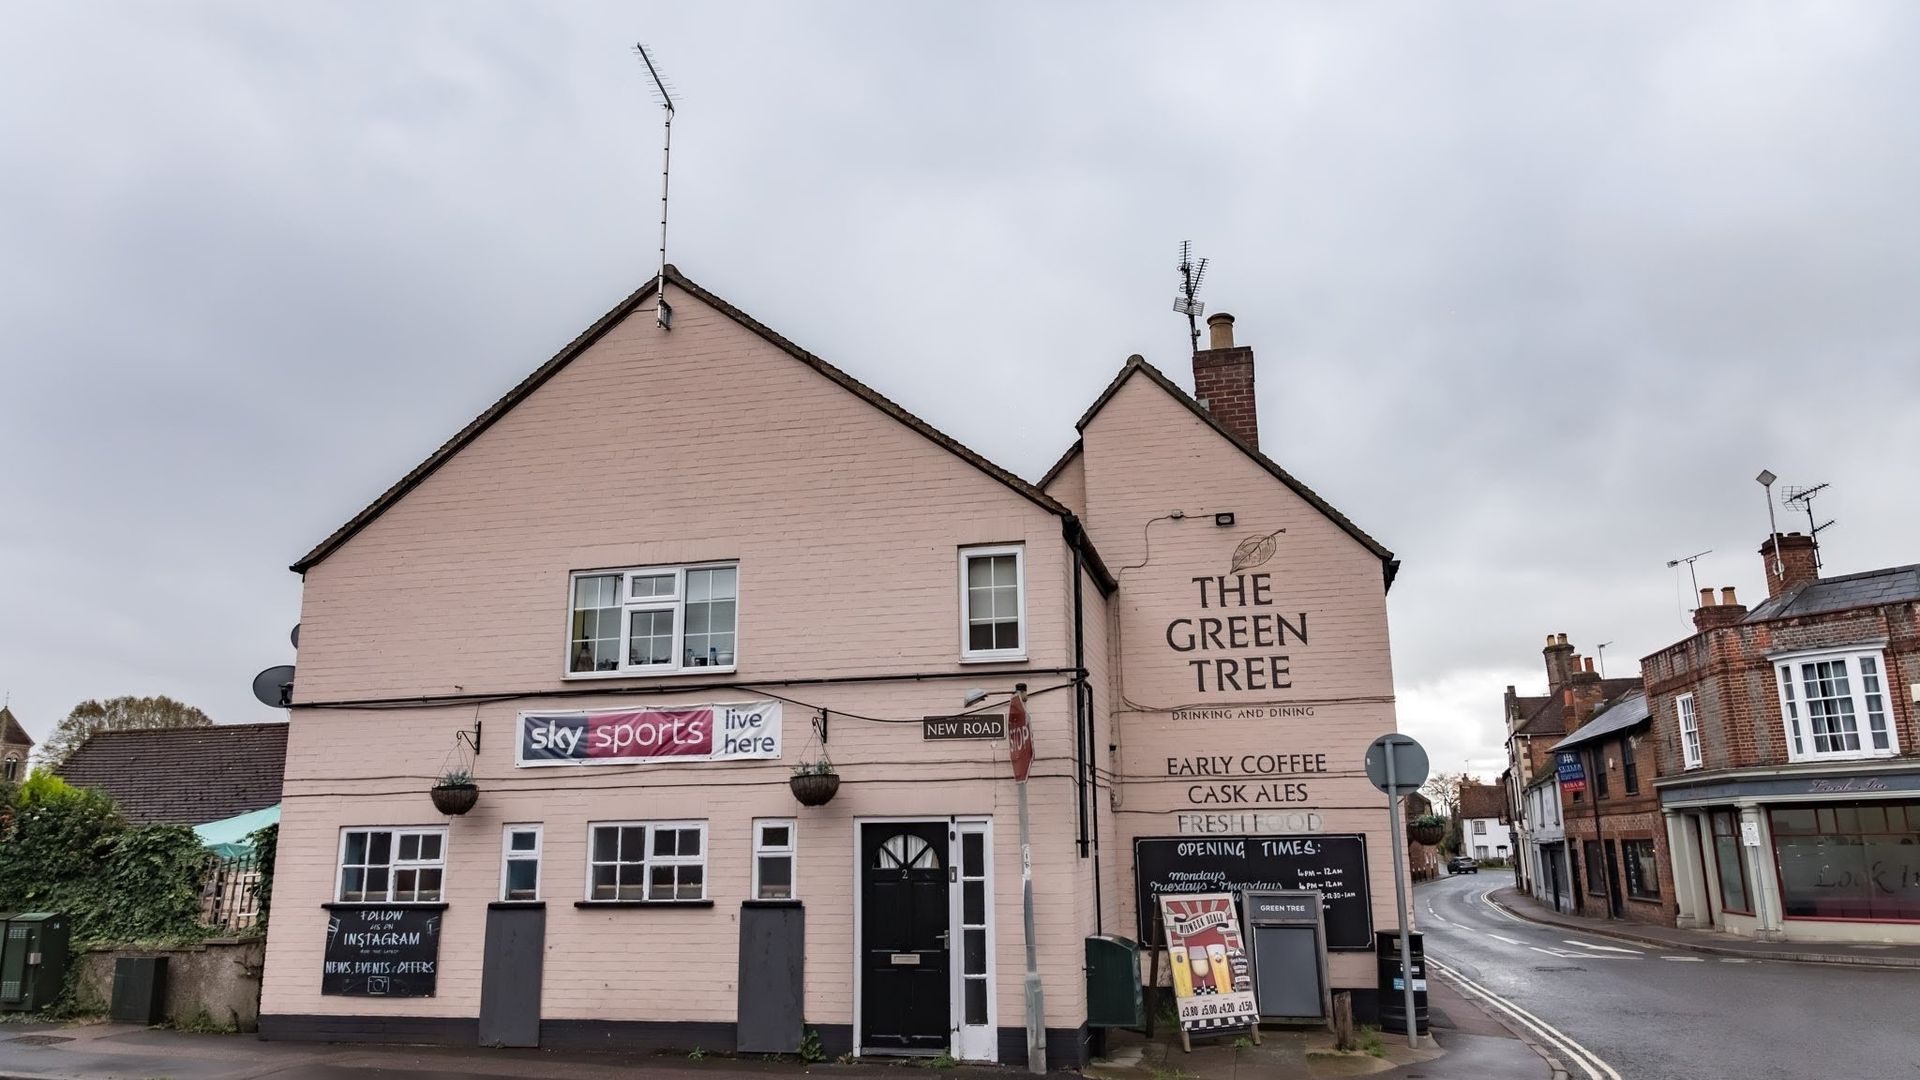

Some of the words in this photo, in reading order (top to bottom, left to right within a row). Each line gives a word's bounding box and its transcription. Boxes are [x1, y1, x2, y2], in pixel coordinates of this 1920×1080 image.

[1192, 573, 1273, 609] THE
[1166, 612, 1308, 652] GREEN
[1188, 655, 1292, 692] TREE
[725, 709, 762, 730] live
[1172, 709, 1233, 721] DRINKING
[1237, 708, 1264, 718] AND
[1269, 706, 1315, 717] DINING
[531, 719, 584, 755] sky
[595, 717, 704, 753] sports
[927, 723, 958, 736] NEW
[963, 721, 1002, 735] ROAD
[724, 733, 775, 754] here
[1009, 725, 1029, 753] STOP
[1167, 756, 1233, 775] EARLY
[1240, 753, 1327, 774] COFFEE
[1188, 785, 1248, 804] CASK
[1255, 783, 1308, 803] ALES
[1177, 814, 1245, 833] FRESH
[1177, 841, 1246, 859] OPENING
[1261, 840, 1321, 858] TIMES:
[902, 869, 908, 879] 2
[1168, 870, 1226, 883] Mondays
[1323, 867, 1343, 875] 12AM
[1150, 881, 1208, 893] Tuesdays
[361, 910, 404, 921] FOLLOW
[344, 932, 420, 948] INSTAGRAM
[355, 961, 391, 974] EVENTS
[397, 961, 435, 974] OFFERS
